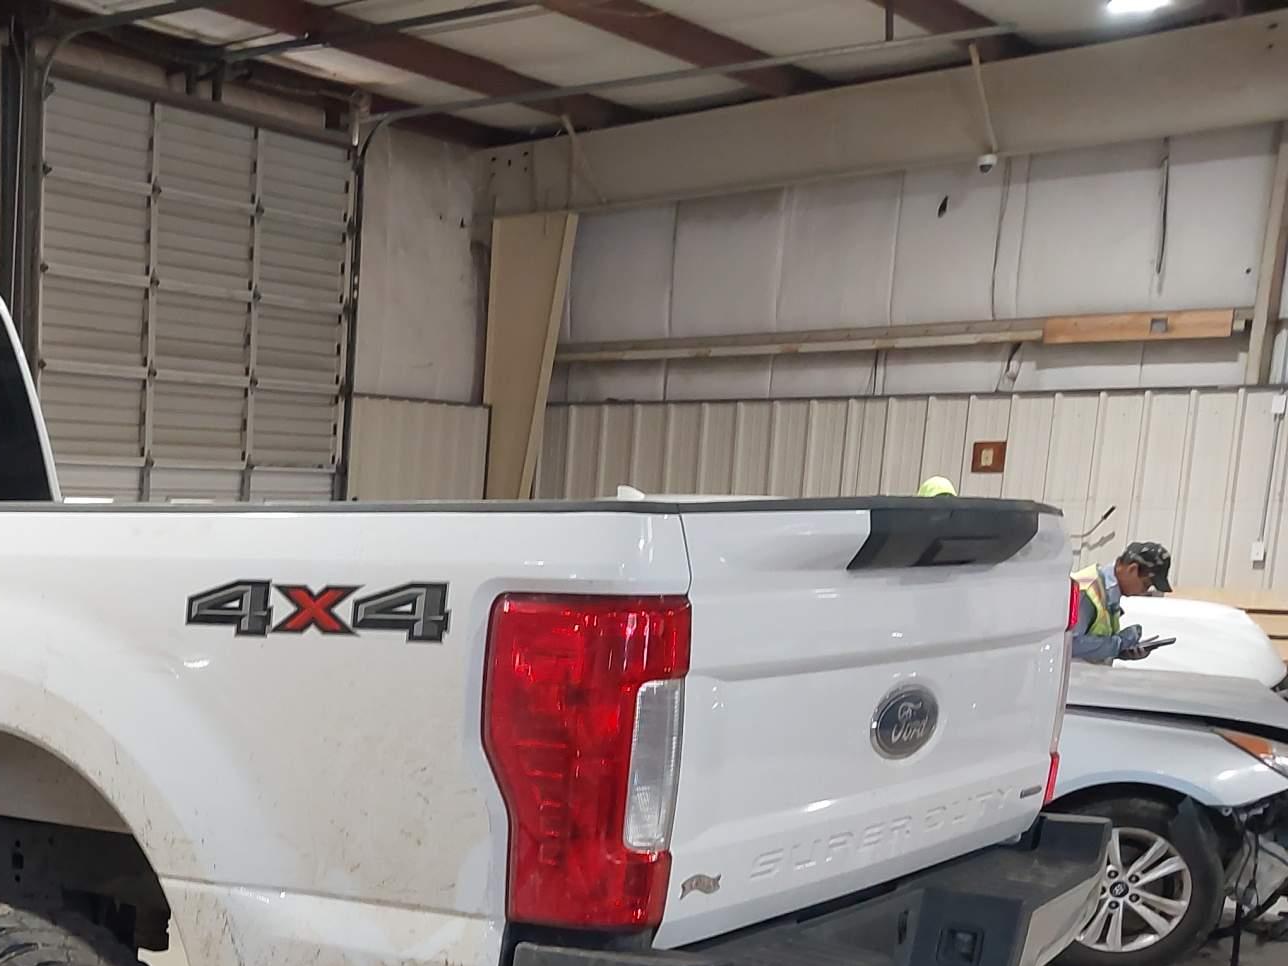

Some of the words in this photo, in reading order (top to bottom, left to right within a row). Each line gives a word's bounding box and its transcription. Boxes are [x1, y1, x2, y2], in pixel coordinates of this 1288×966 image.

[891, 701, 930, 744] Ford
[748, 814, 914, 880] SUPER
[921, 785, 1015, 833] DUTY
